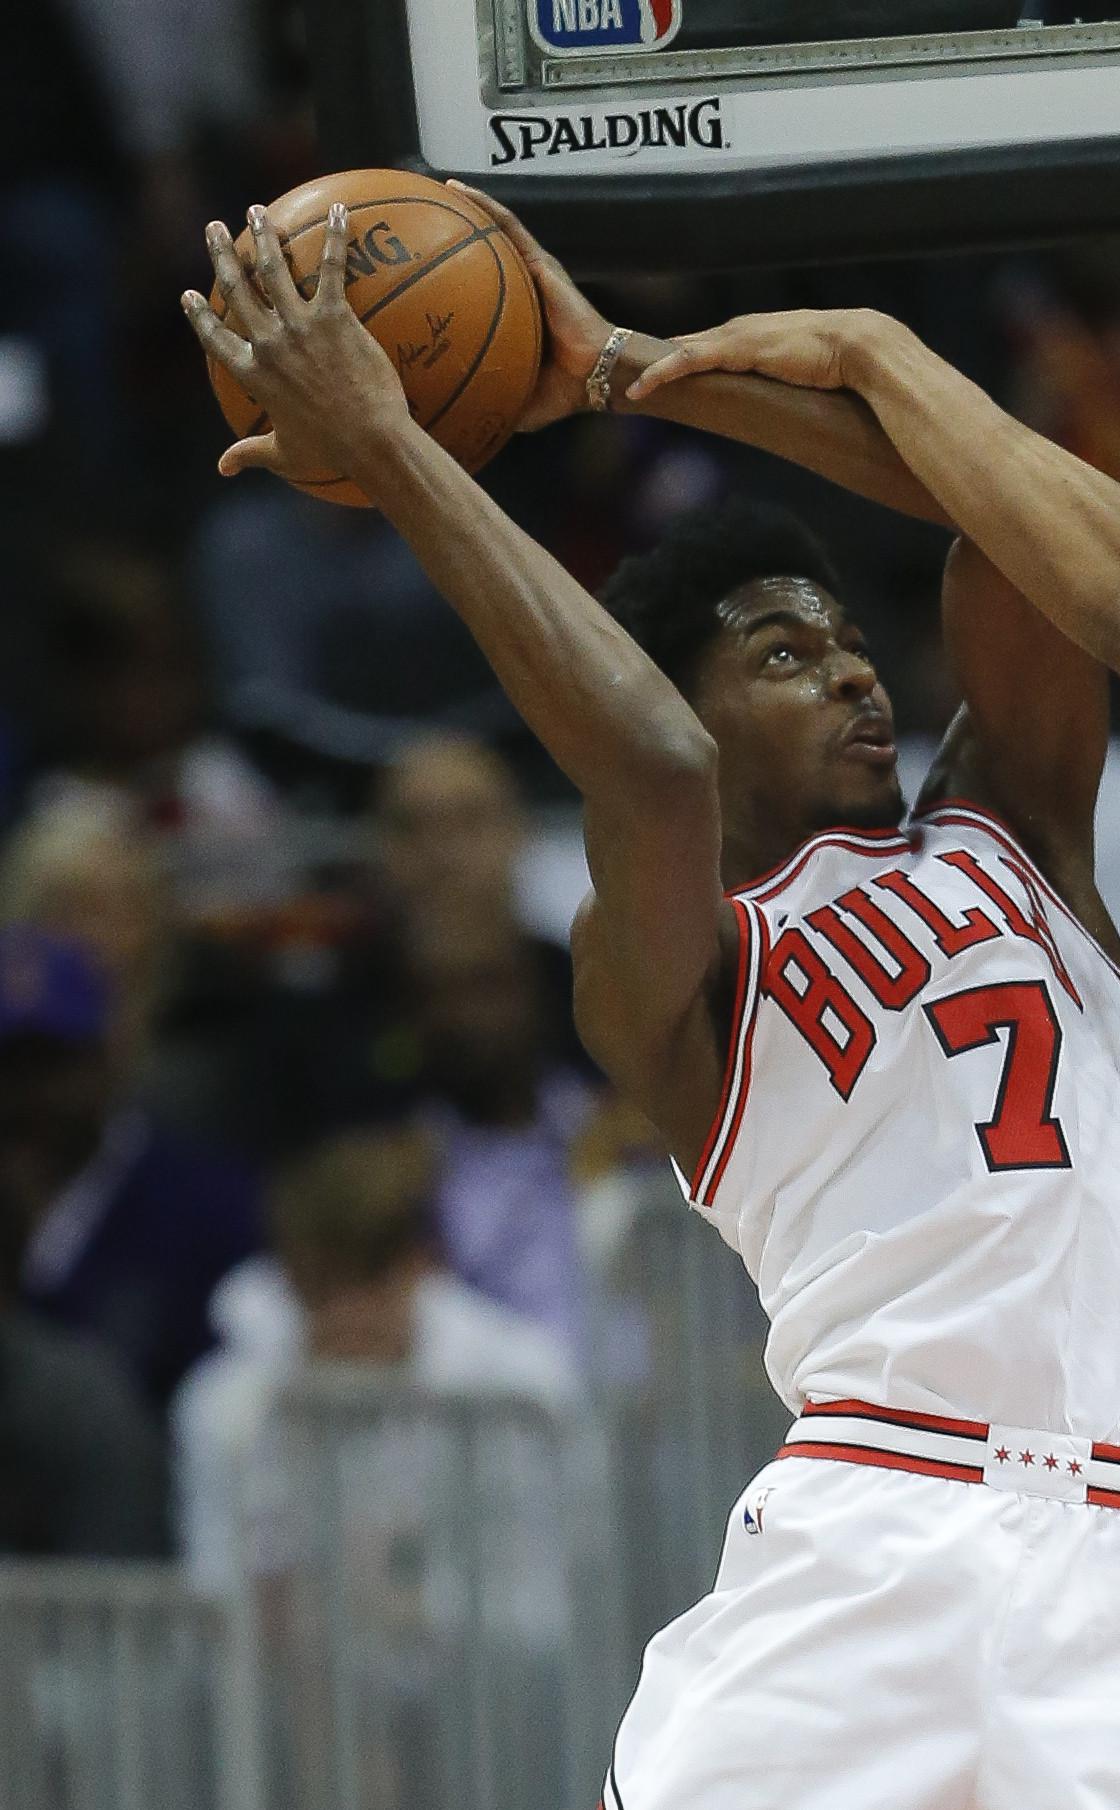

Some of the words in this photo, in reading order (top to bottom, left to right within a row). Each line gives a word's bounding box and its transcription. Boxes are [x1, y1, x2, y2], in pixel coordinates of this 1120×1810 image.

[552, 0, 624, 32] NBA
[489, 97, 724, 166] SPALDING
[921, 979, 1074, 1173] 7
